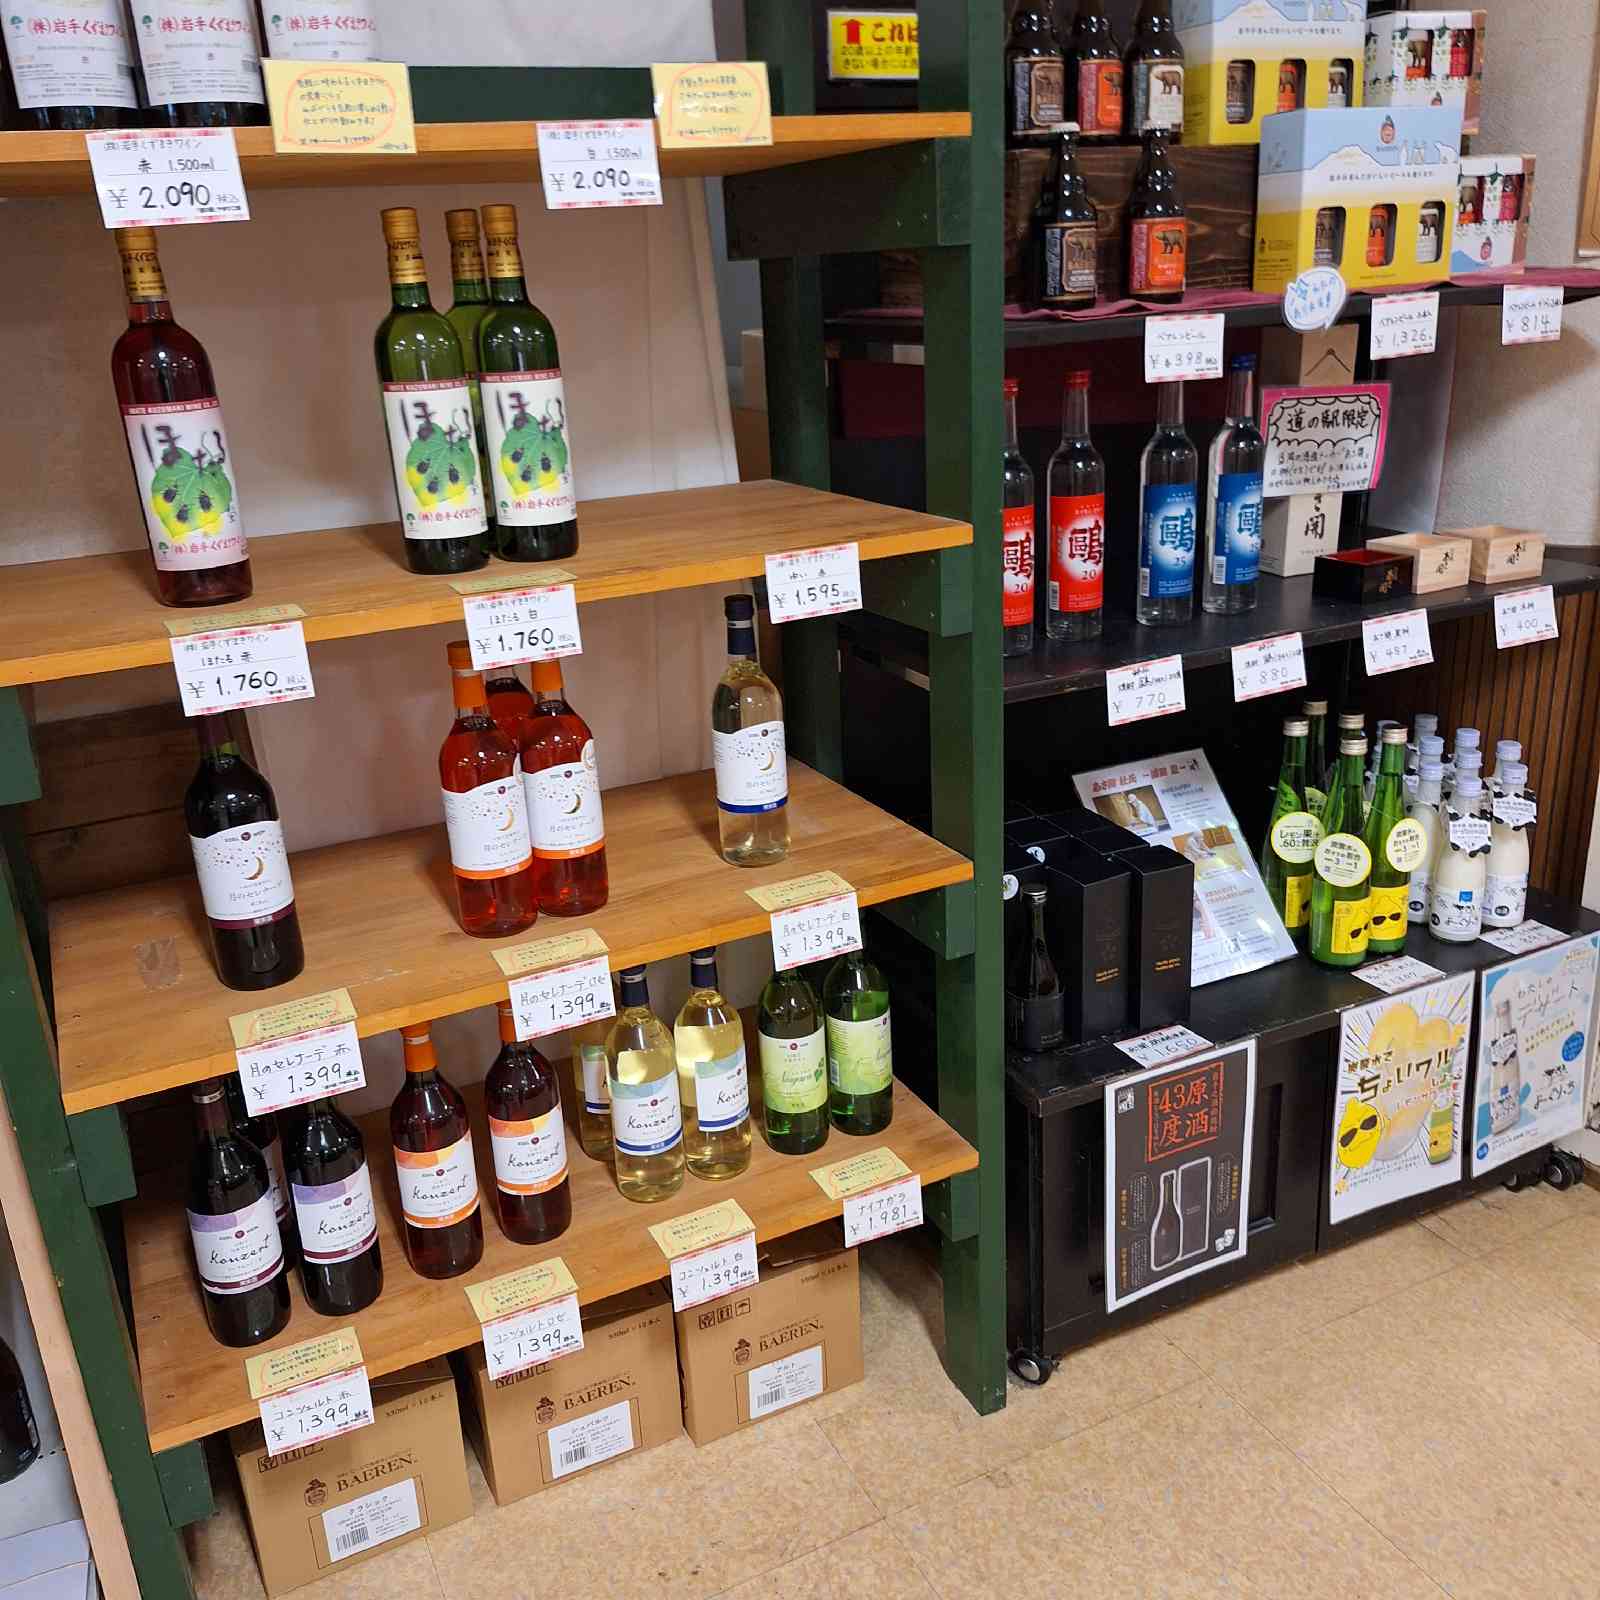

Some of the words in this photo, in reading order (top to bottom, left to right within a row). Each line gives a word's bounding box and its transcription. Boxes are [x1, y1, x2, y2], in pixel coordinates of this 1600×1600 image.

[548, 172, 566, 192] ¥
[107, 188, 128, 208] ¥
[1081, 569, 1098, 580] 20
[1014, 583, 1028, 594] 20
[774, 592, 786, 608] ¥
[475, 637, 491, 654] ¥
[185, 681, 206, 698] ¥
[519, 1011, 533, 1027] ¥
[1357, 1048, 1450, 1103] ちょいワル
[251, 1083, 266, 1099] ¥
[758, 1319, 821, 1352] BAEREN
[563, 1376, 633, 1411] BAEREN
[335, 1453, 416, 1493] BAEREN
